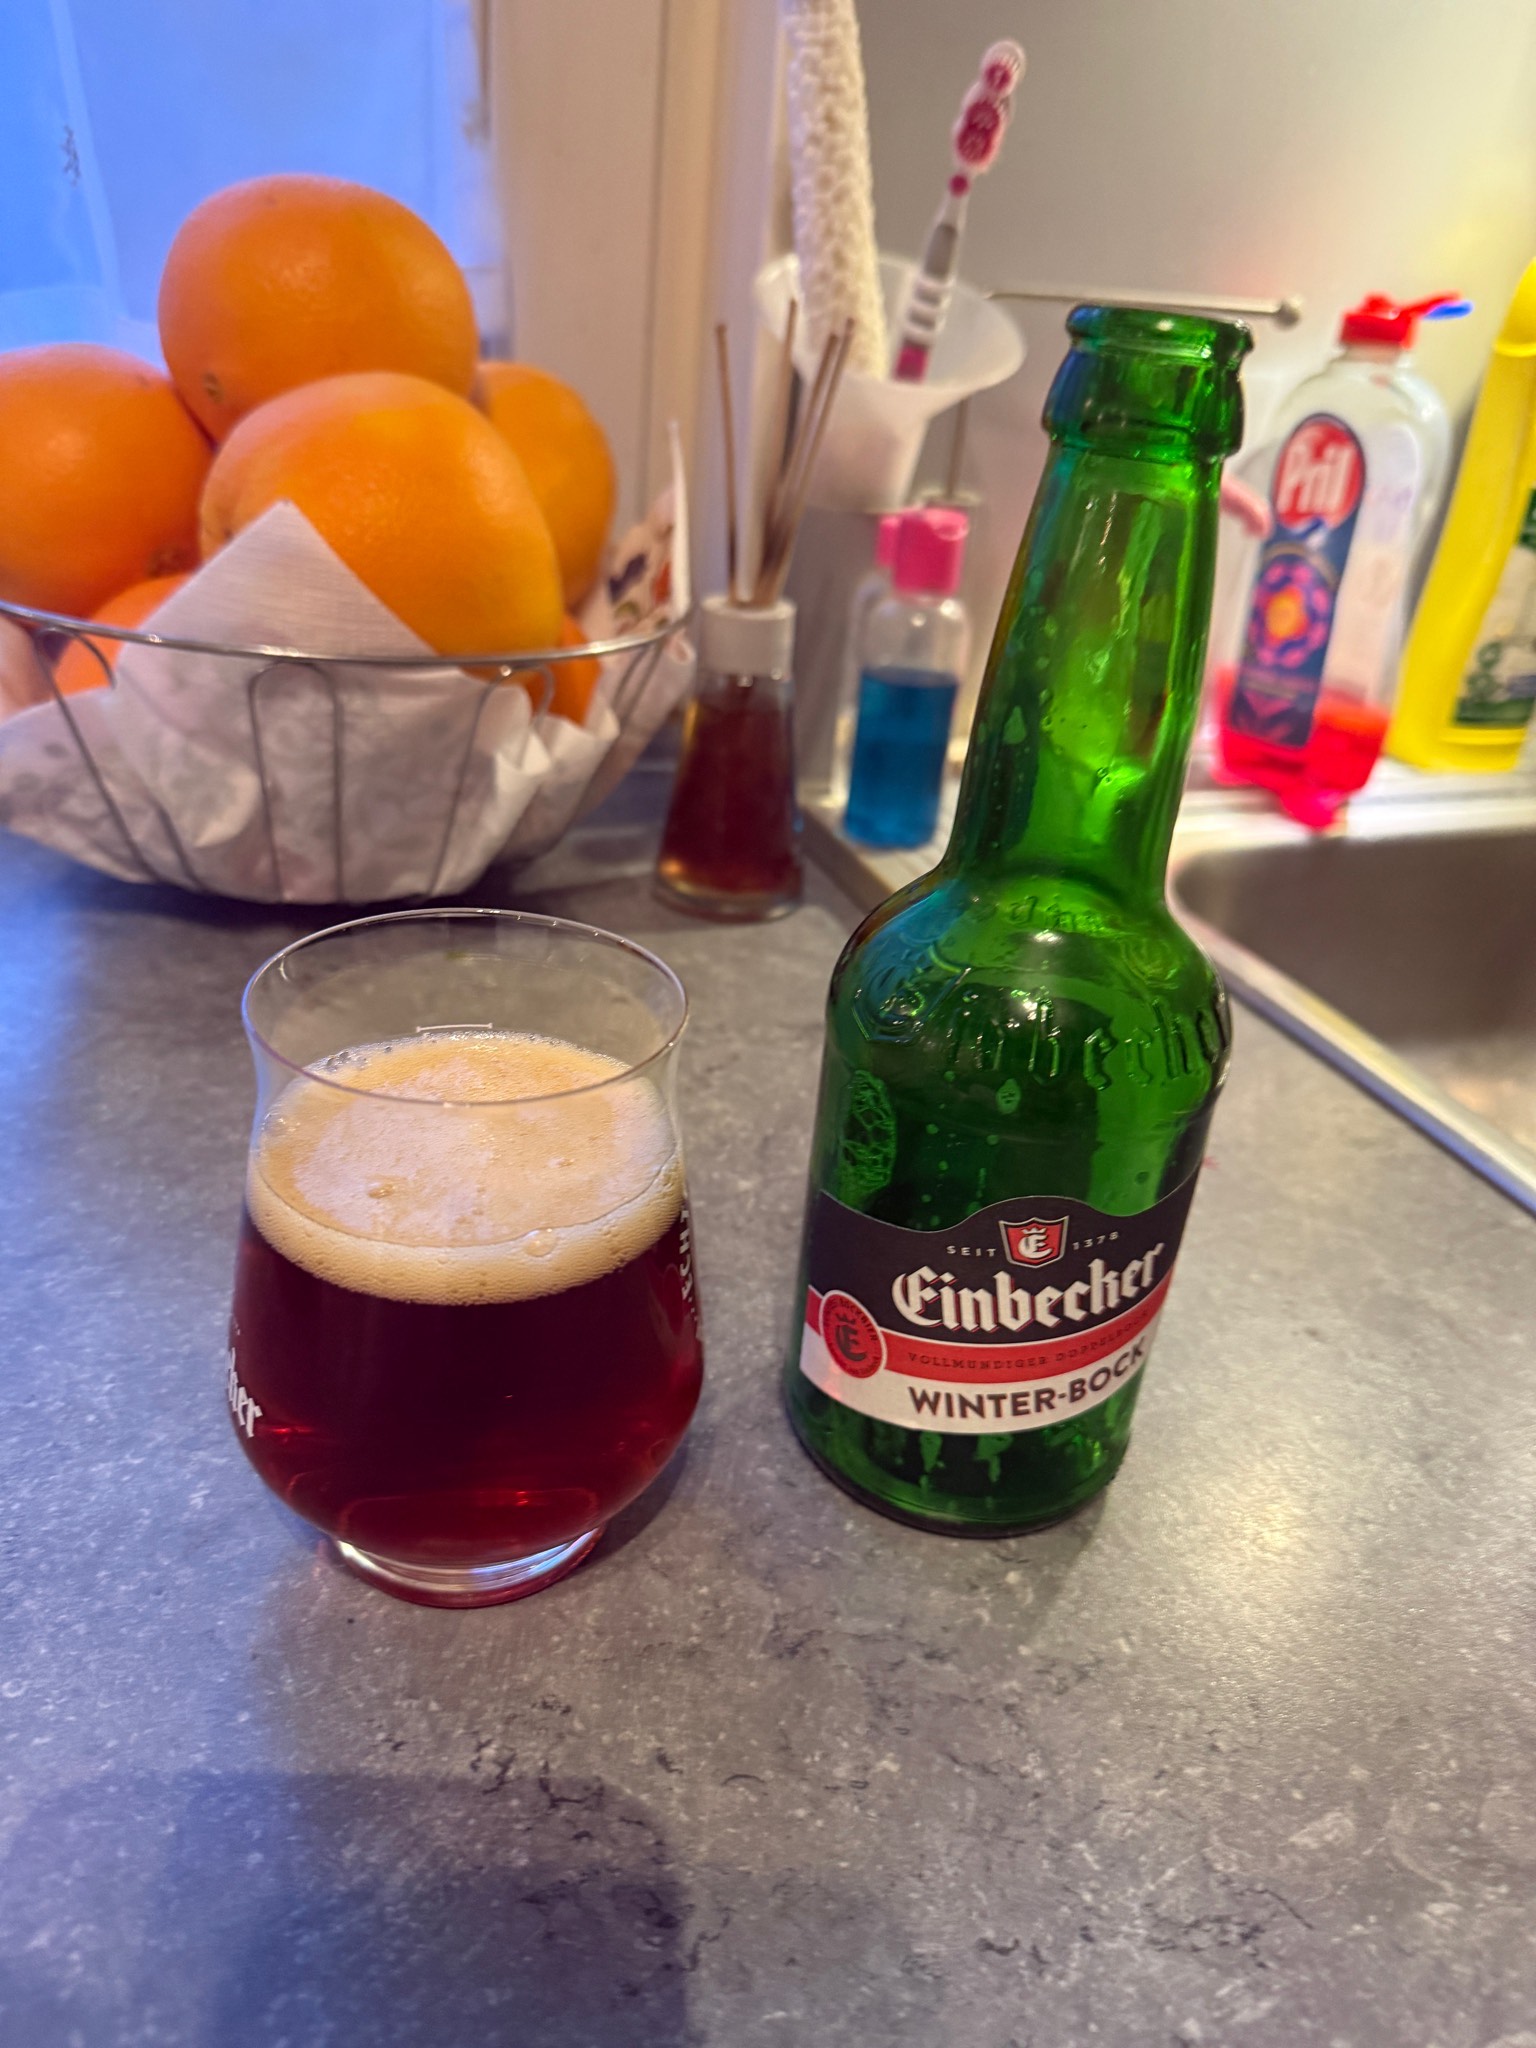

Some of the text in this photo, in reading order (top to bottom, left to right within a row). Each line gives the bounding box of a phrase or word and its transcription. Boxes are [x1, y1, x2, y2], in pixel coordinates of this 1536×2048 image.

[946, 1231, 1119, 1257] SEIT 1378
[891, 1242, 1165, 1332] Einbecker
[907, 1351, 1048, 1369] VOLLMUNDIGER
[907, 1335, 1146, 1419] WINTER-BOCK
